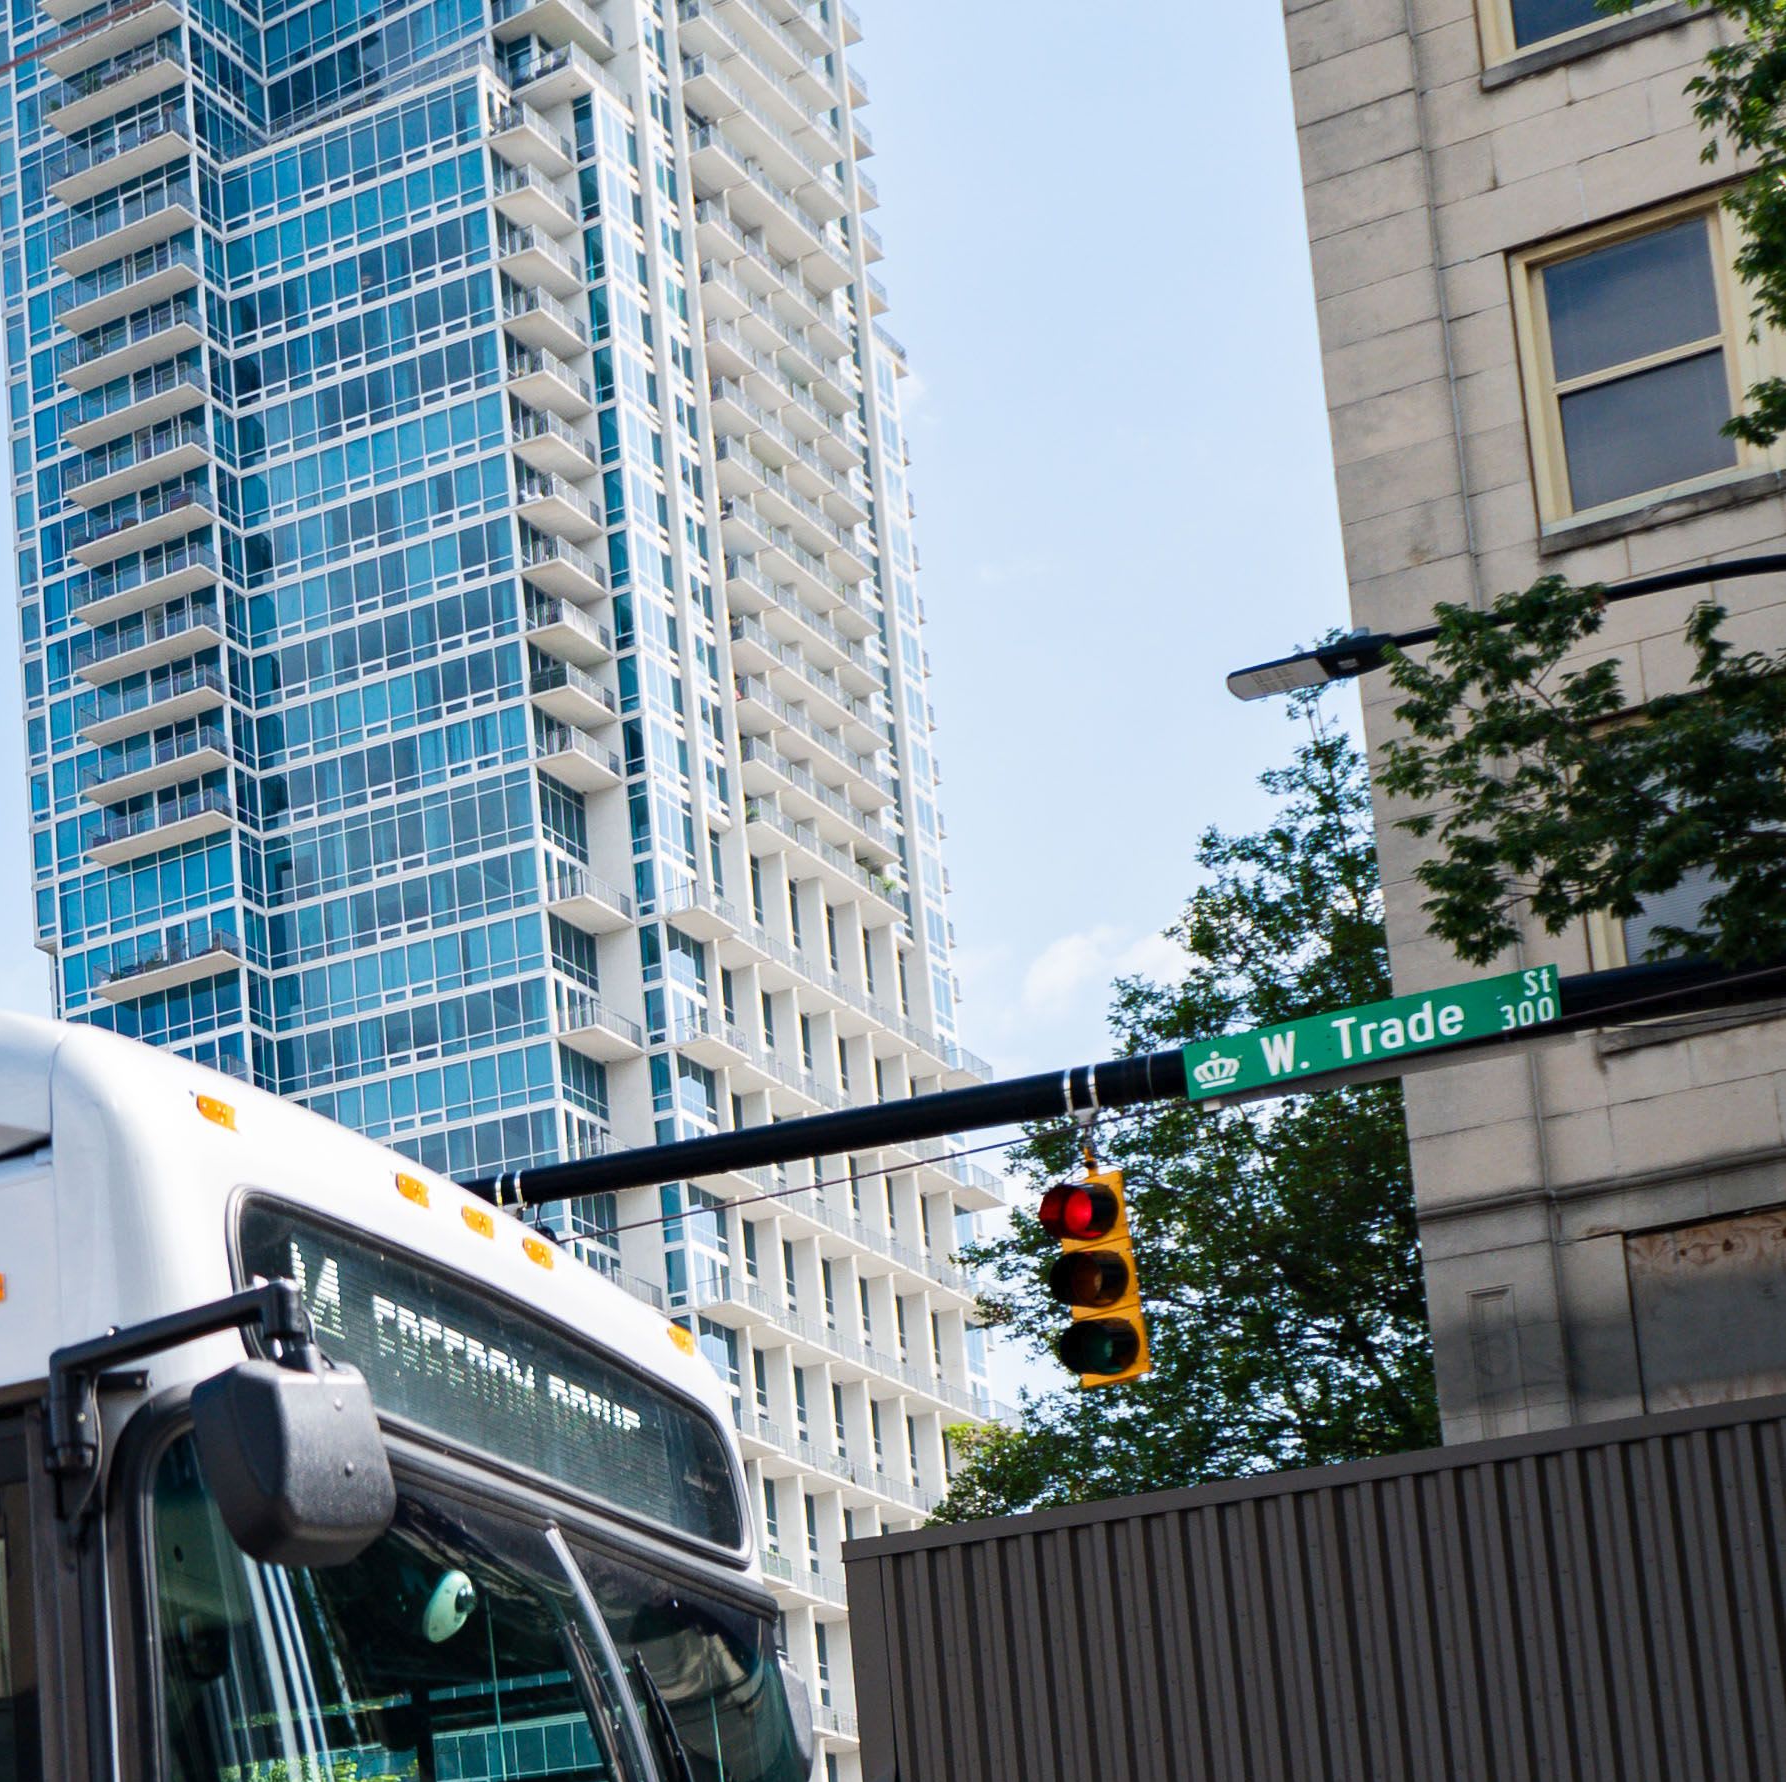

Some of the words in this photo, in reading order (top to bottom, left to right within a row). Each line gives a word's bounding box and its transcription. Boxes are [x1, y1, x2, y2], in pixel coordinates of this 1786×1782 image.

[1260, 1031, 1310, 1077] W.
[1331, 1001, 1465, 1060] Trade
[1523, 967, 1552, 997] St
[1500, 997, 1555, 1031] 300
